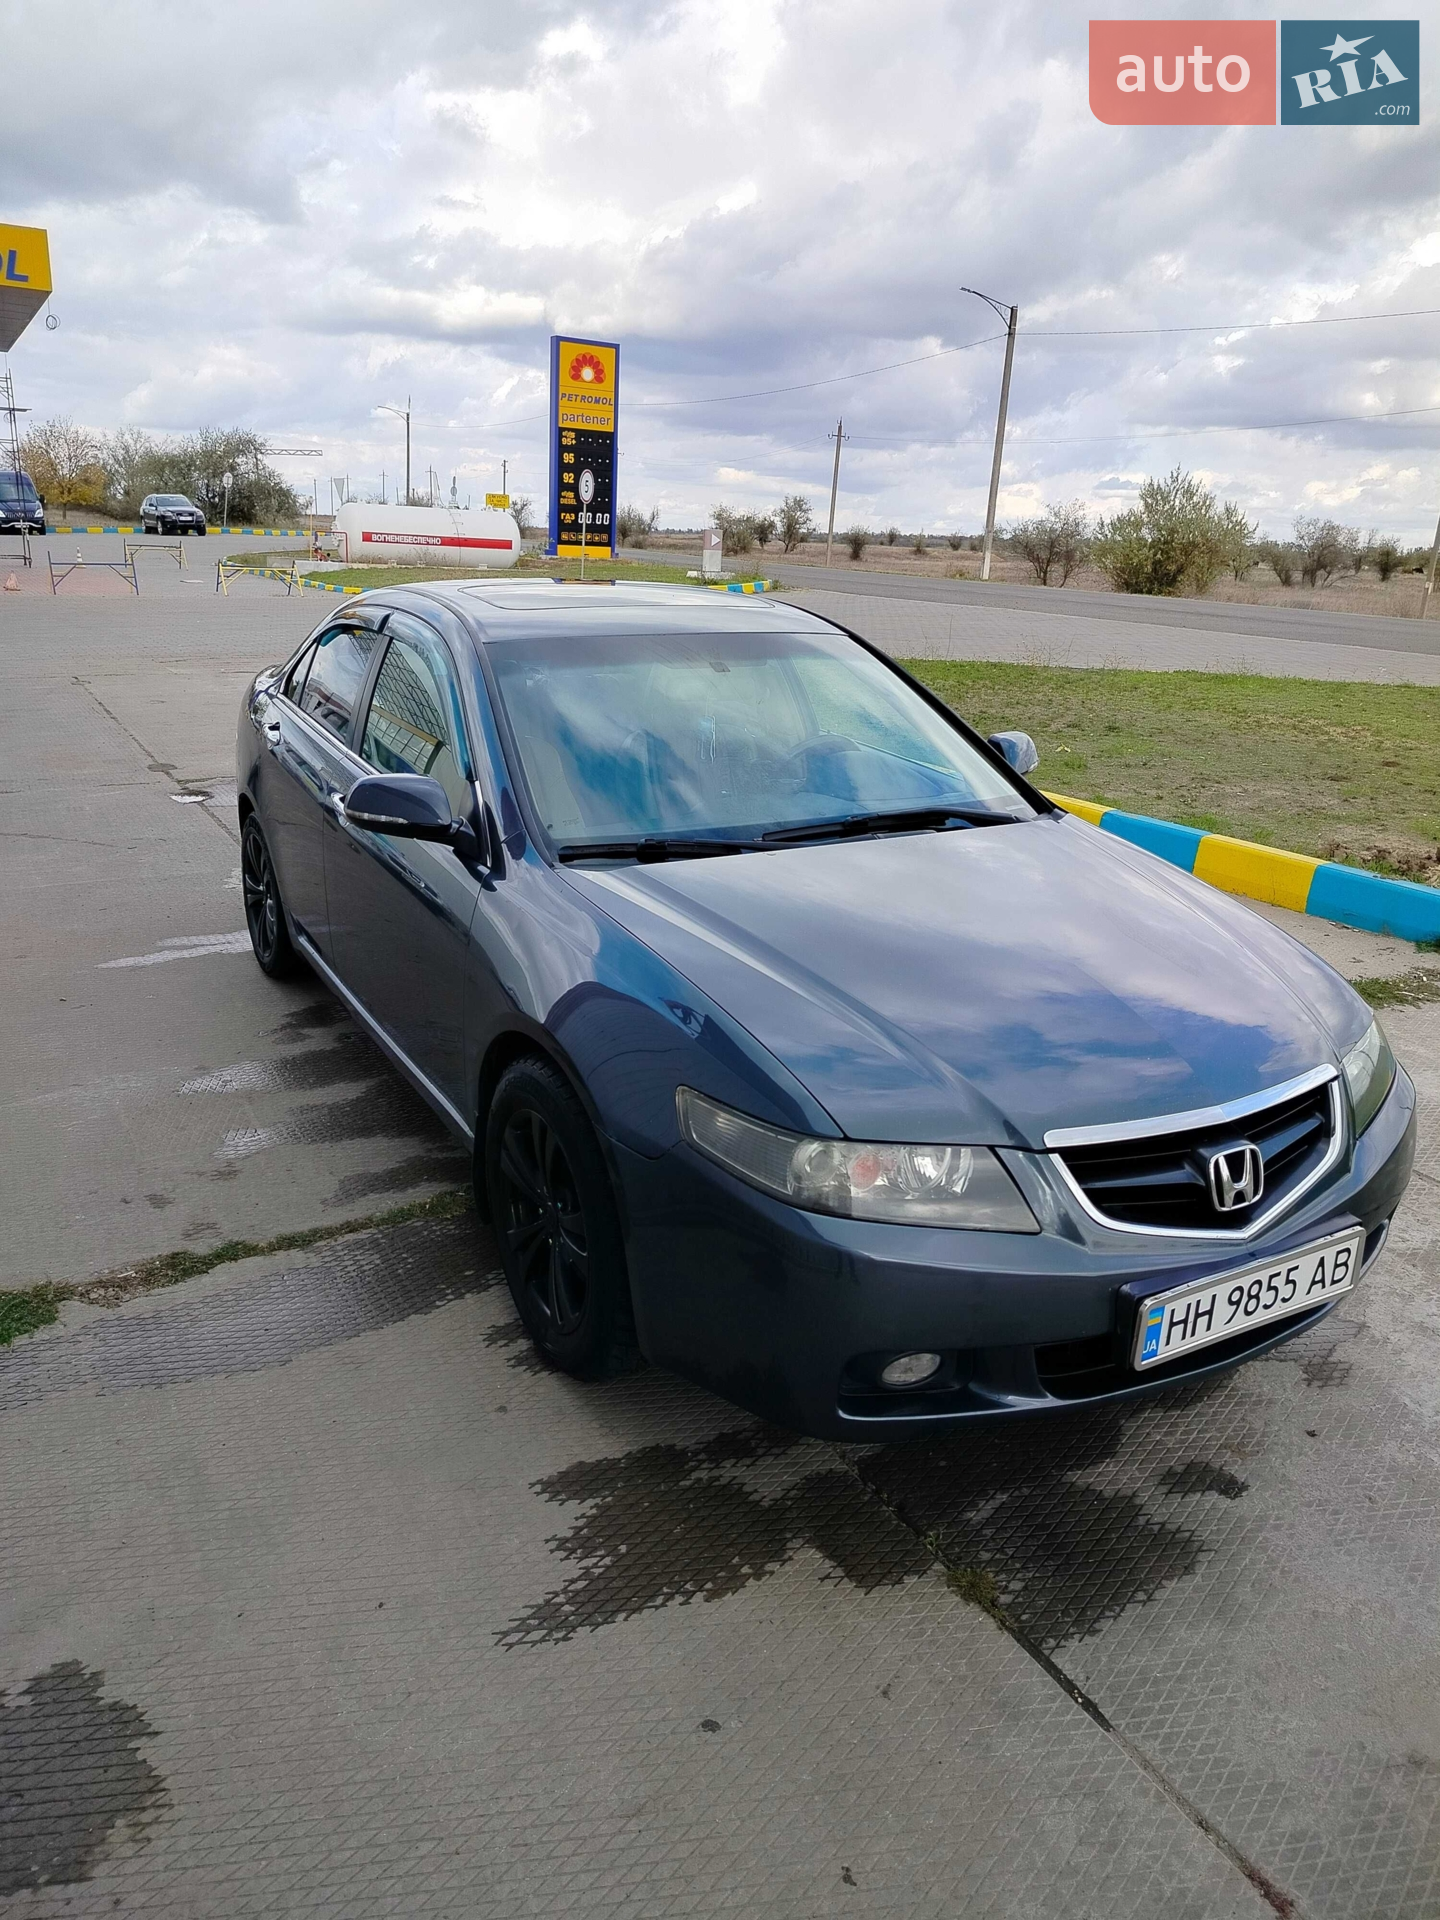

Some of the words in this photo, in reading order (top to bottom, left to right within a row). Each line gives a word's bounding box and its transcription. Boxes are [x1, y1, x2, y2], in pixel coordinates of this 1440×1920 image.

[0, 249, 29, 283] L
[560, 392, 614, 406] PETROMOL
[561, 412, 611, 426] partener
[563, 452, 575, 464] 95
[563, 472, 575, 484] 92
[584, 480, 590, 493] 5
[560, 512, 575, 520] ГАЗ
[1165, 1293, 1217, 1346] HH
[1223, 1264, 1300, 1325] 9855
[1306, 1247, 1352, 1296] AB
